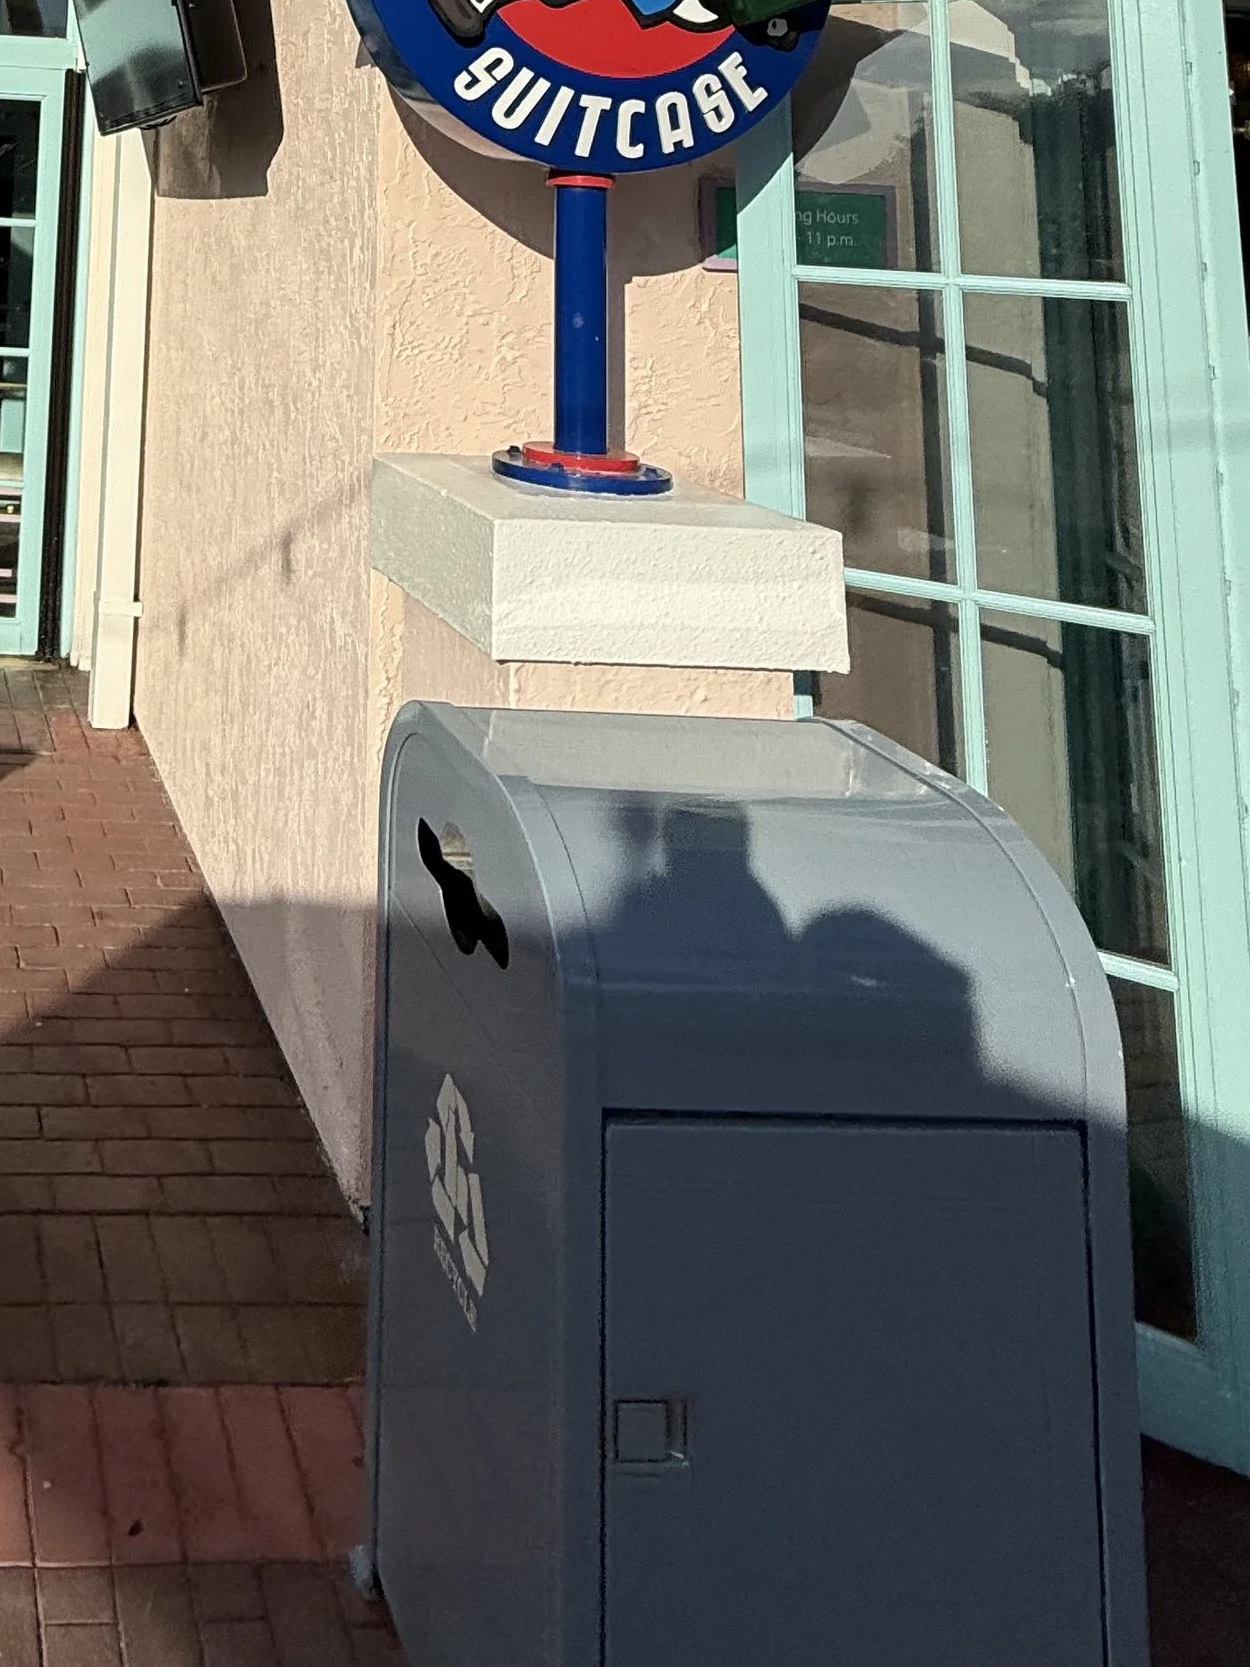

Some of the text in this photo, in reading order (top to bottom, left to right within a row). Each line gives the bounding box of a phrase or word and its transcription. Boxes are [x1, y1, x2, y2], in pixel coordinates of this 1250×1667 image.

[453, 47, 769, 159] SUITCASE
[816, 208, 859, 224] Hours
[806, 230, 821, 245] 11
